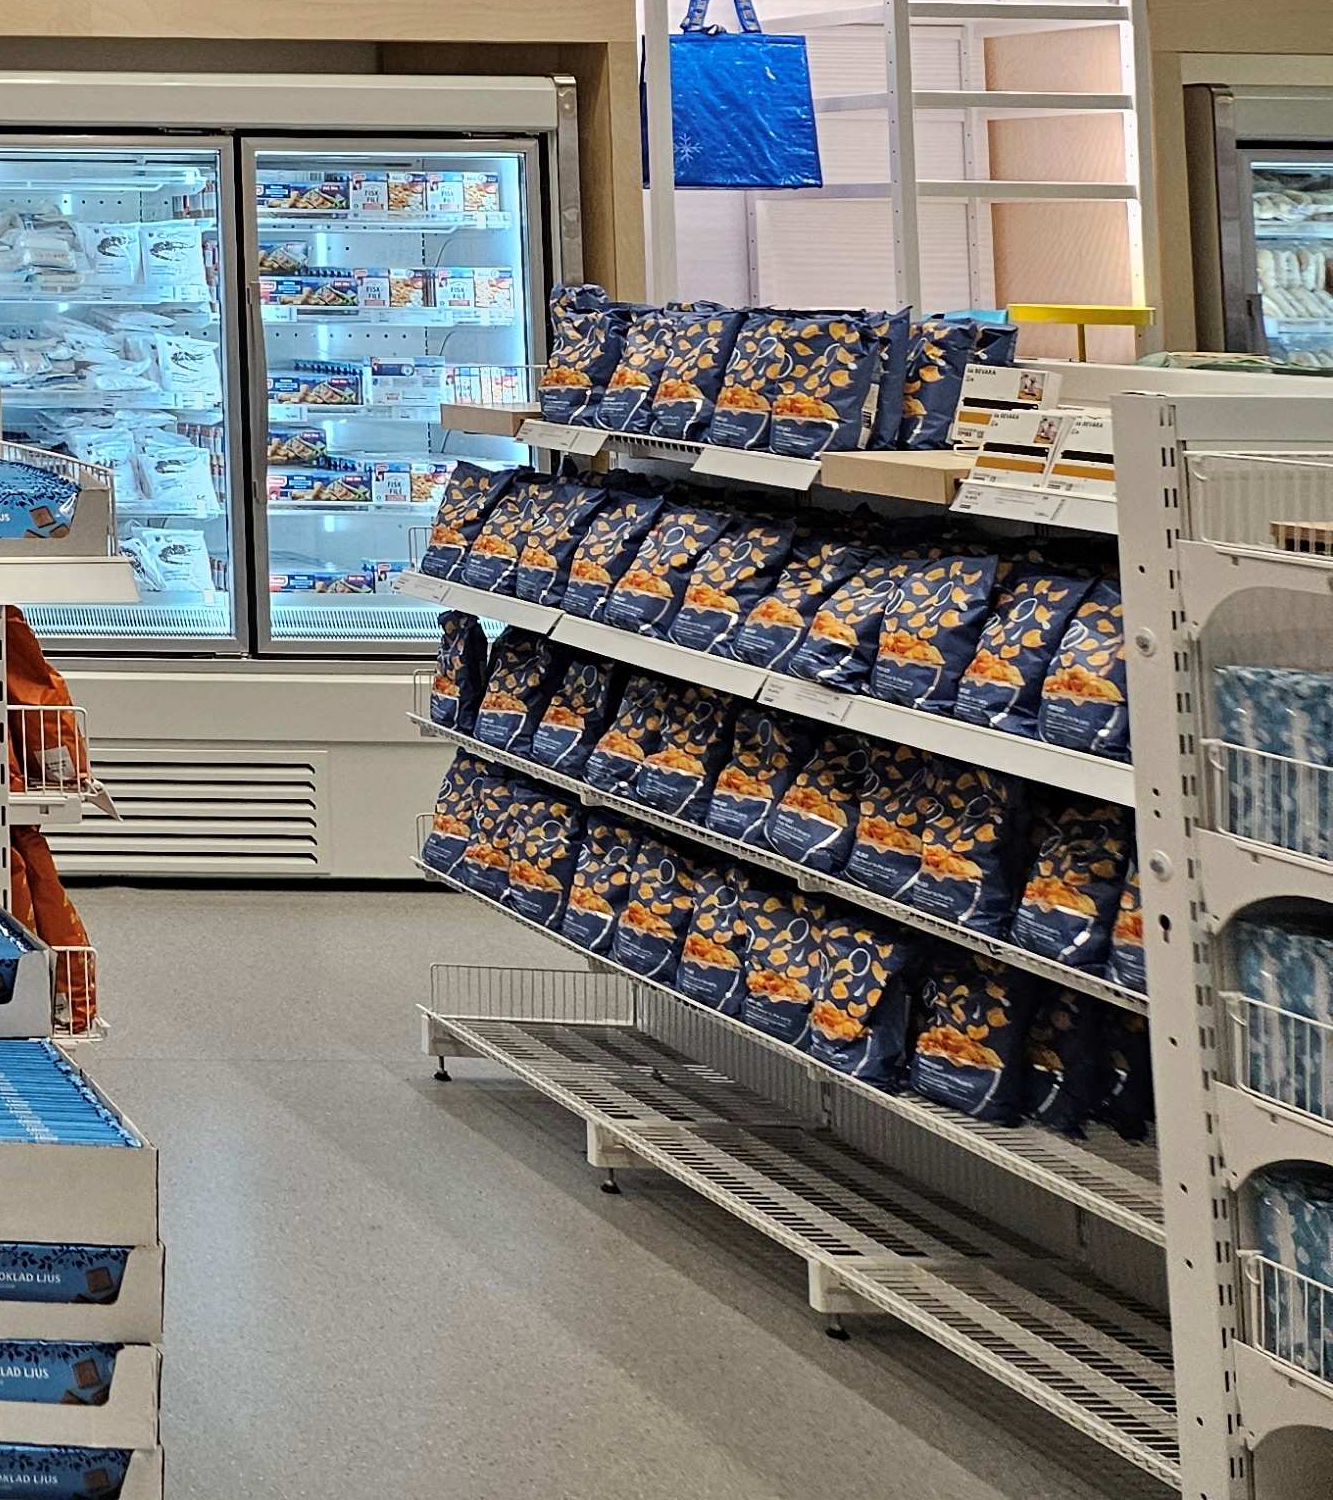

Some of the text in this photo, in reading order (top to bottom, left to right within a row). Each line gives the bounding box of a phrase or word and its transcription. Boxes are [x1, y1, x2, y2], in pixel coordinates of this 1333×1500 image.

[36, 1273, 61, 1283] LJUS
[25, 1367, 48, 1378] LJUS
[33, 1476, 58, 1484] LJUS
